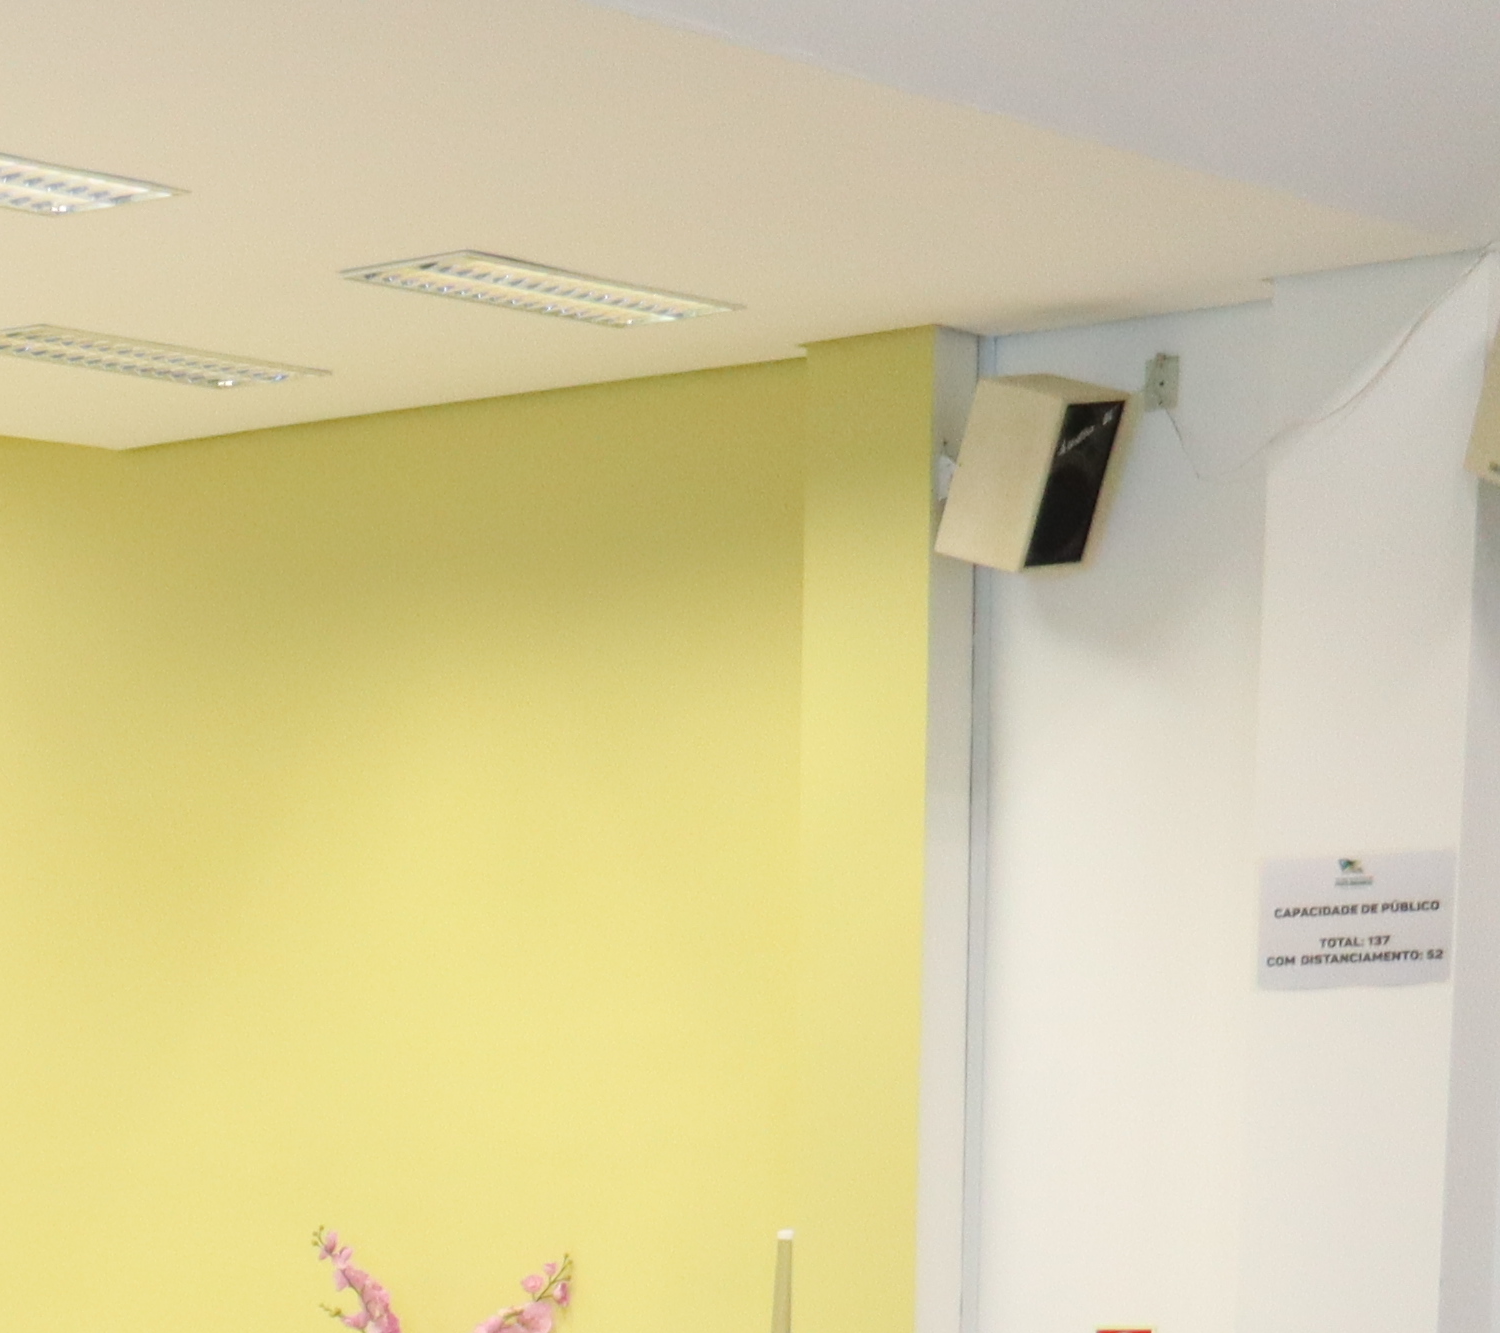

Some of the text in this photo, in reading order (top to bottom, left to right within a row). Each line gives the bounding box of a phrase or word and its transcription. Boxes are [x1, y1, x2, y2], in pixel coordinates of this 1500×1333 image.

[1274, 899, 1440, 919] CAPACIDADE DE PÚBLICO
[1319, 935, 1391, 949] TOTAL: 137
[1267, 949, 1443, 967] COM DISTANCIAMENTO: 52
